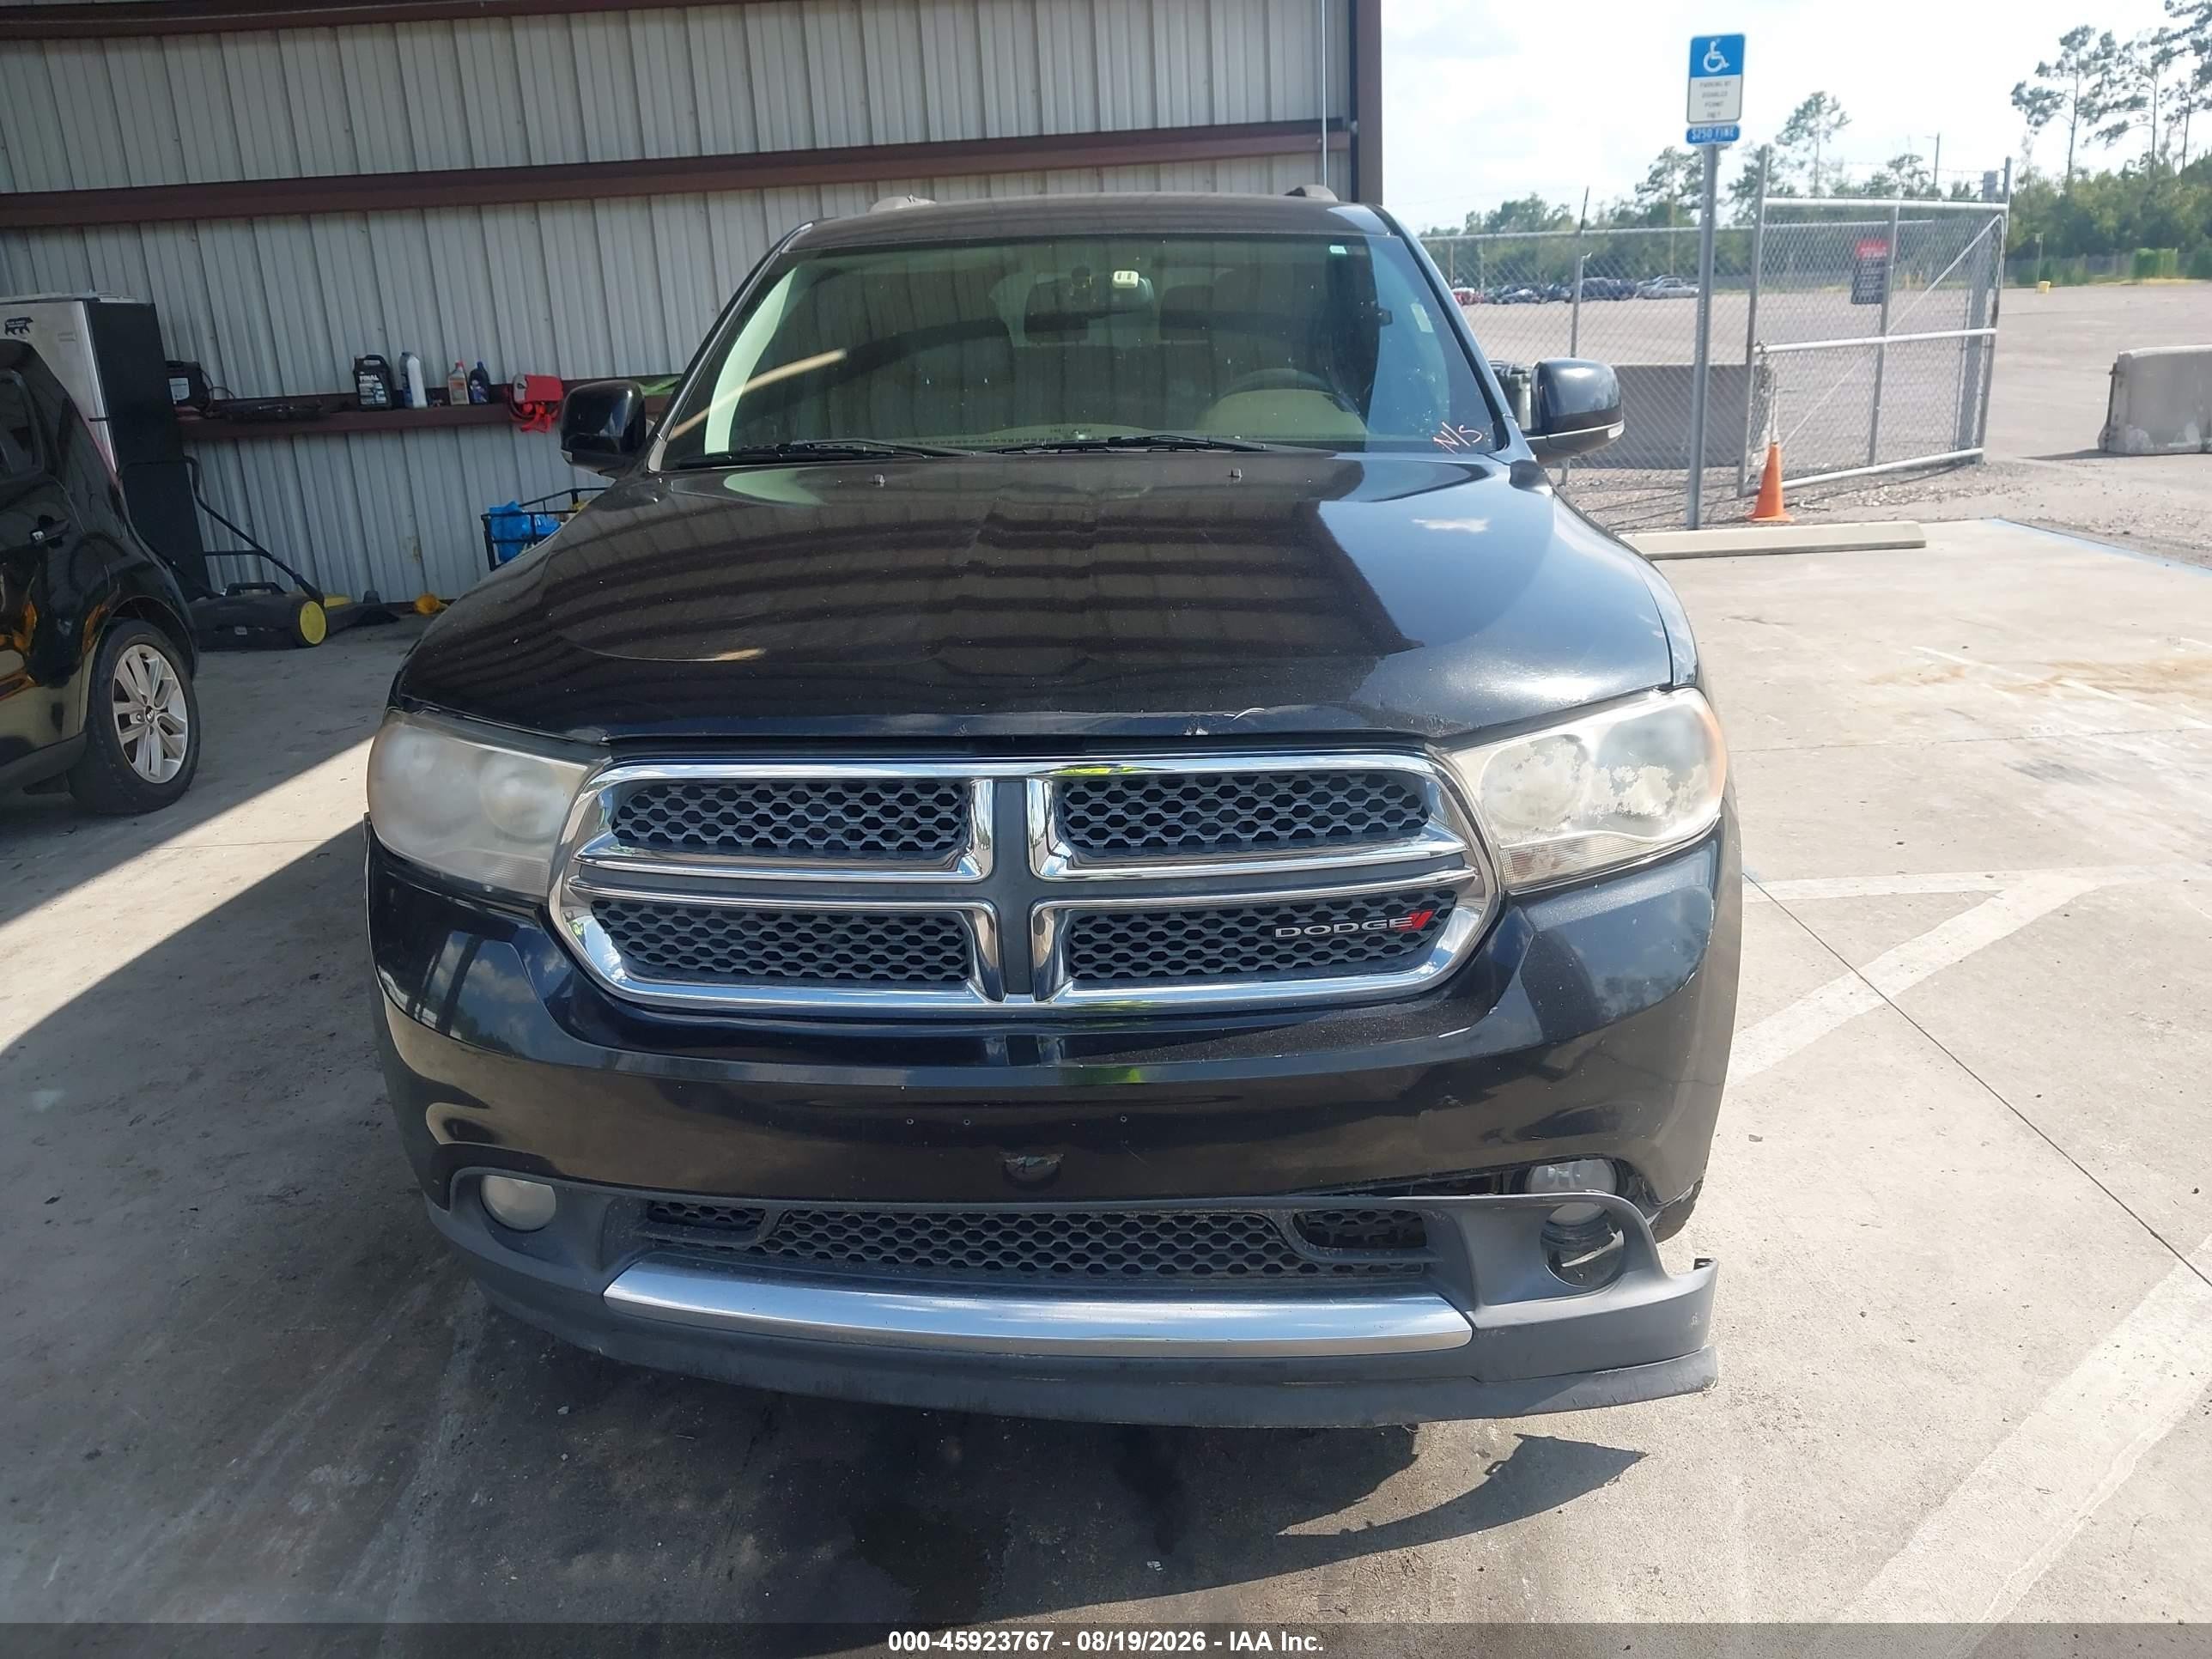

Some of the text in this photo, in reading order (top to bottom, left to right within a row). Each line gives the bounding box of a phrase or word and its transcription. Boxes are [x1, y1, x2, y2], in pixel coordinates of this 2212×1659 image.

[1692, 126, 1735, 141] $250 FINE
[1274, 916, 1413, 938] DODGE
